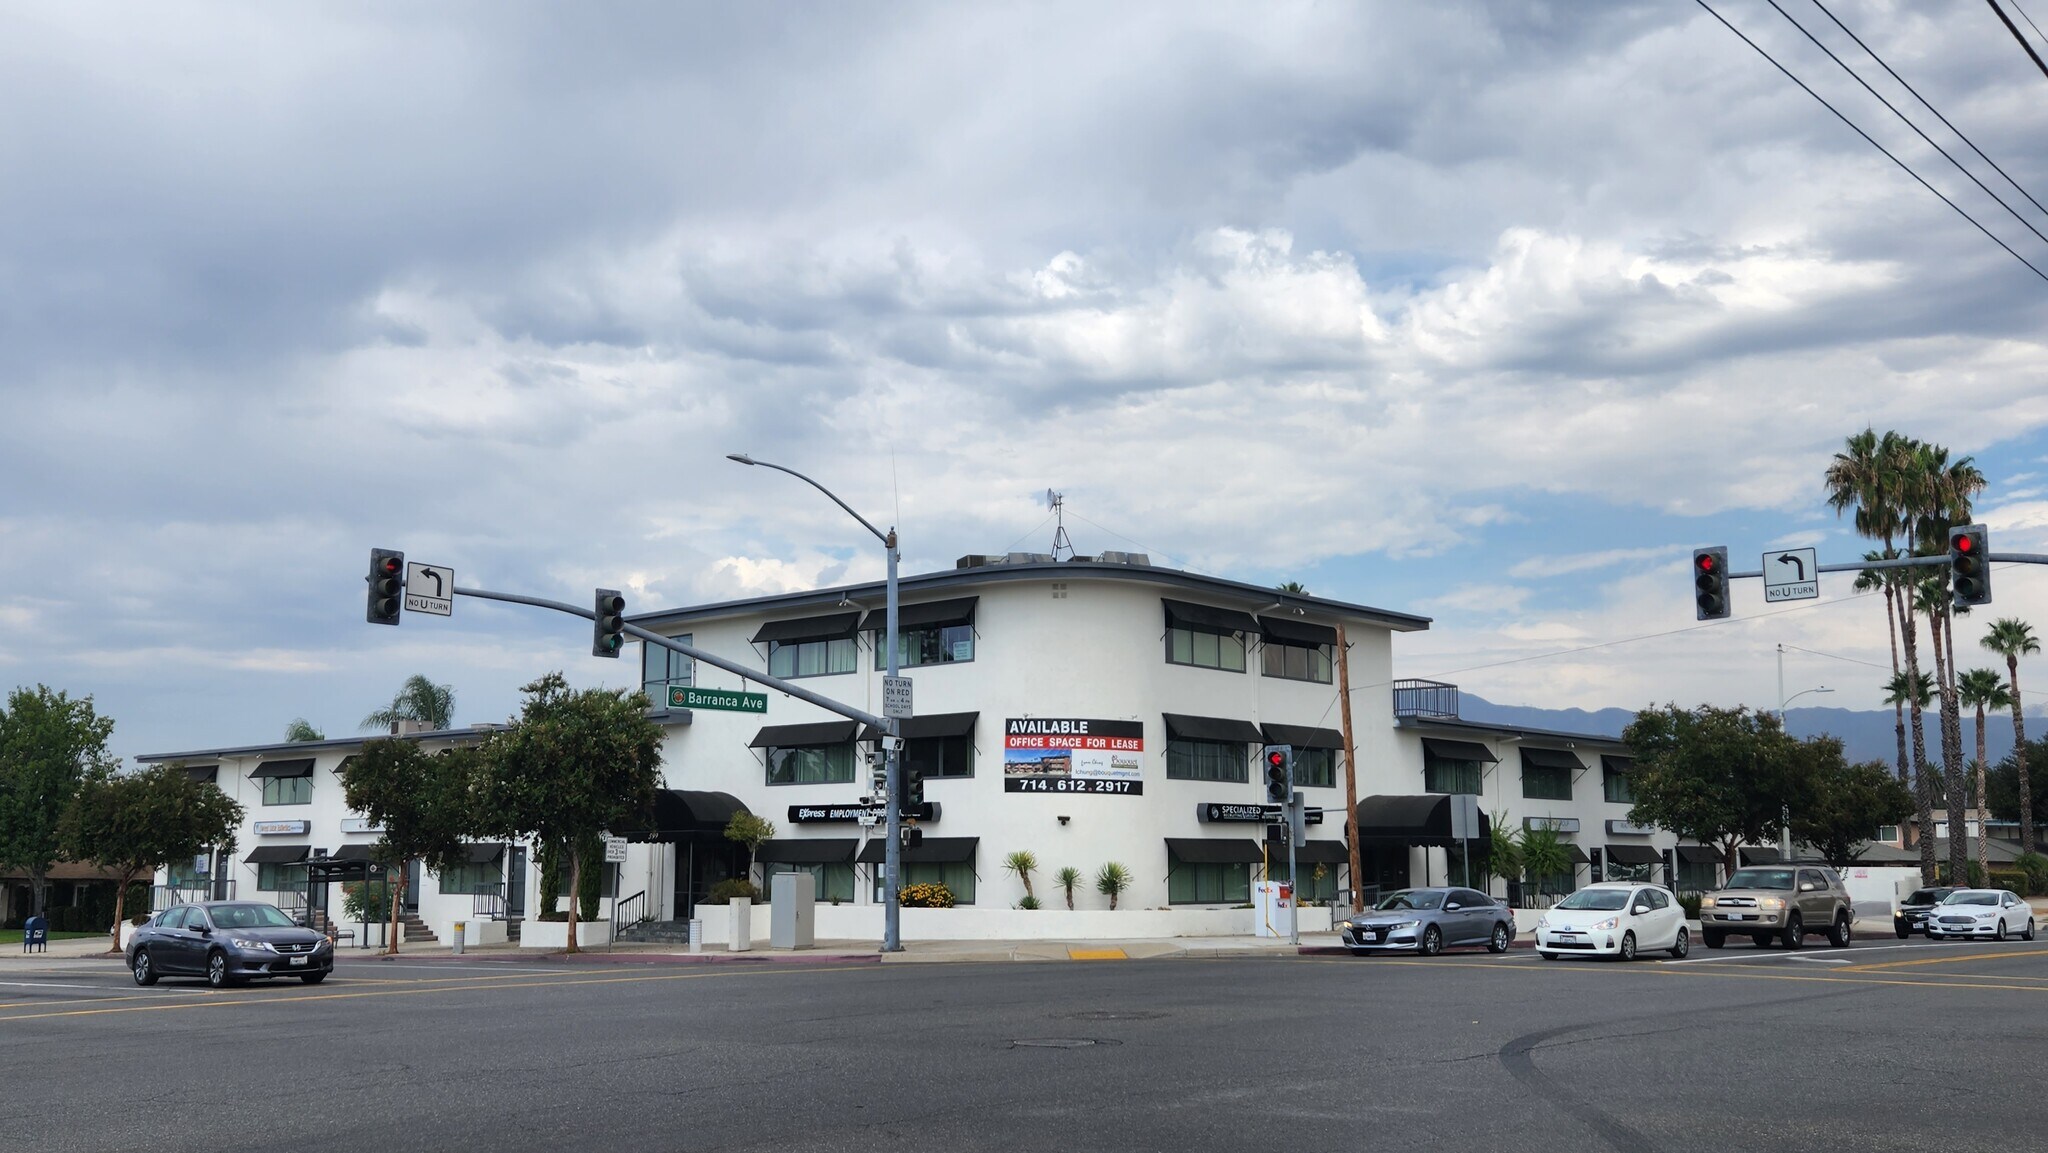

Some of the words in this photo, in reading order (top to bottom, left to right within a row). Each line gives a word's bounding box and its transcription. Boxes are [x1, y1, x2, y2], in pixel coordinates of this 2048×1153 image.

[1769, 589, 1781, 597] NO
[1782, 587, 1791, 597] U
[1792, 586, 1814, 595] TURN
[408, 598, 419, 607] NO
[420, 599, 428, 609] U
[429, 602, 449, 611] TURN
[897, 688, 910, 696] RED
[688, 691, 738, 707] Barranca
[742, 696, 763, 709] Ave
[1009, 720, 1089, 734] AVAILABLE
[1009, 737, 1043, 747] OFFICE
[1049, 737, 1082, 748] SPACE
[1086, 738, 1106, 748] FOR
[1111, 739, 1139, 750] LEASE
[829, 808, 871, 818] EMPLOYMENT
[1222, 805, 1261, 815] SPECIALIZED
